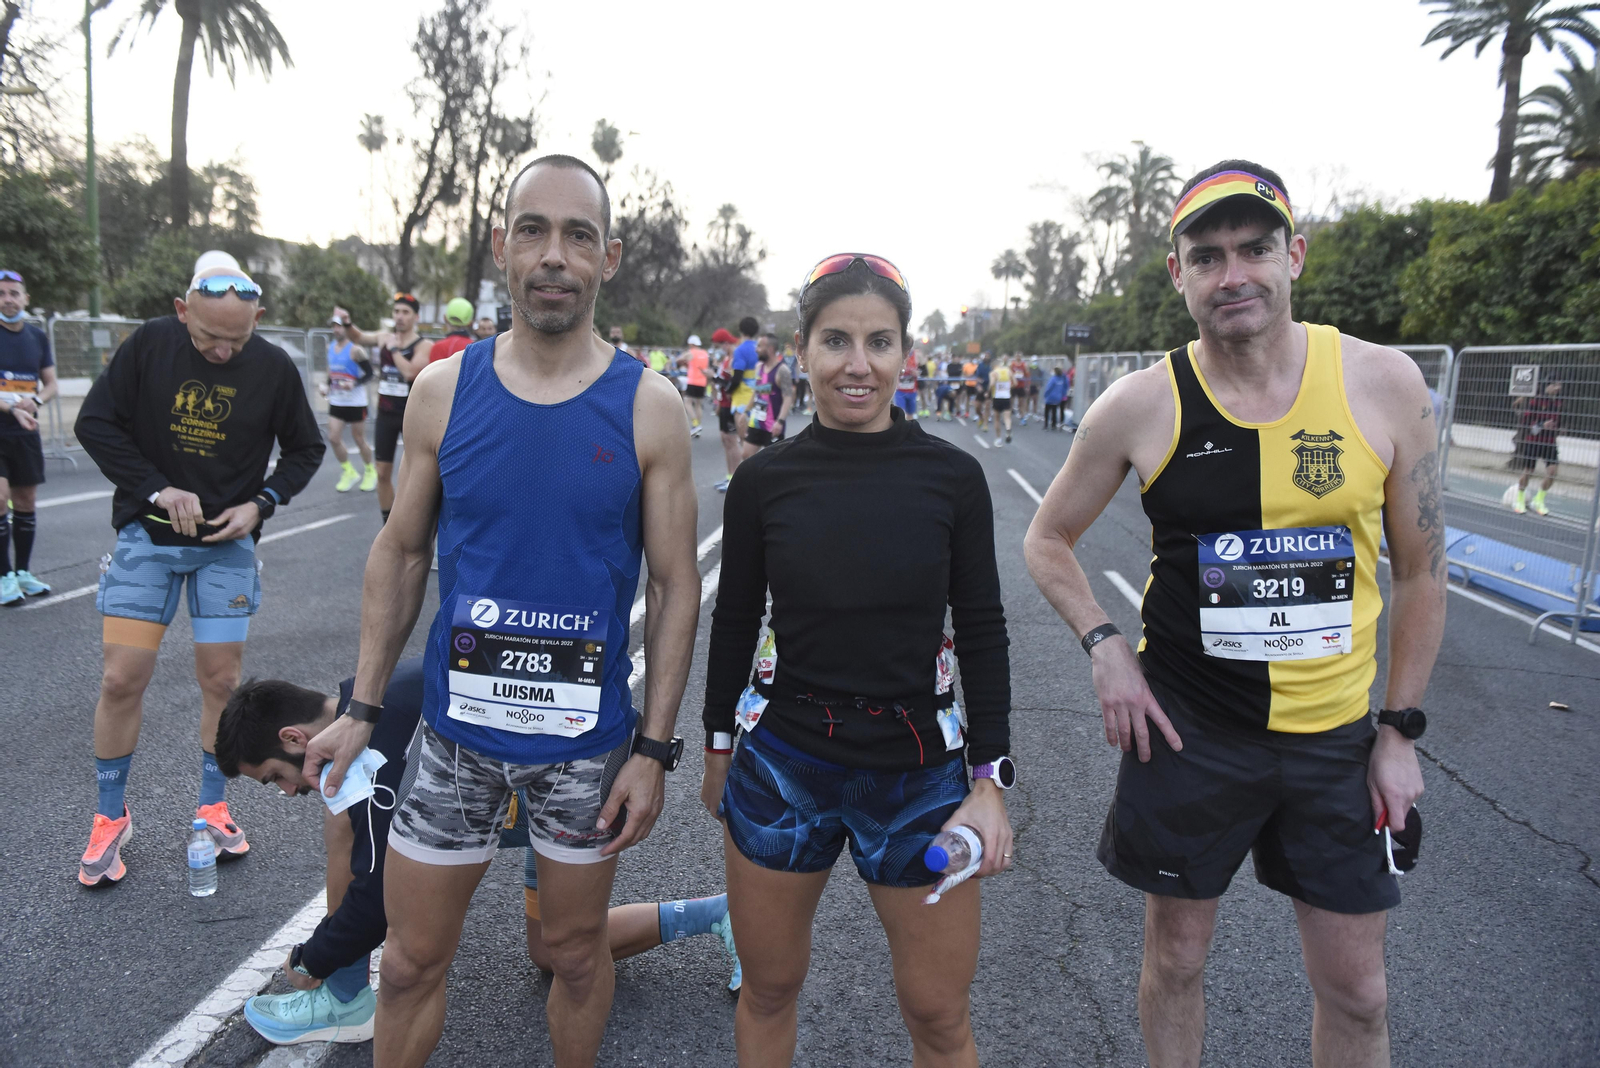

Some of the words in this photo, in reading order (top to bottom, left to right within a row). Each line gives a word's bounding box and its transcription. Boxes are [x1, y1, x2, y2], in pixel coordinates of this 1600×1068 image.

[1257, 182, 1275, 198] PH
[171, 379, 237, 423] 25
[170, 423, 187, 433] DAS
[181, 417, 218, 430] CORRIDA
[1301, 434, 1334, 442] KILKENNY
[1186, 447, 1233, 458] RONHILL
[1296, 477, 1311, 489] CITY
[1311, 477, 1342, 493] HARRIERS
[1249, 533, 1336, 556] ZURICH
[1253, 563, 1280, 571] MARATÓN
[1253, 577, 1305, 599] 3219
[504, 608, 590, 632] ZURICH
[1269, 612, 1290, 627] AL
[484, 633, 503, 641] ZURICH
[504, 635, 531, 644] MARATÓN
[501, 650, 552, 674] 2783
[492, 682, 555, 703] LUISMA
[468, 705, 486, 714] asics
